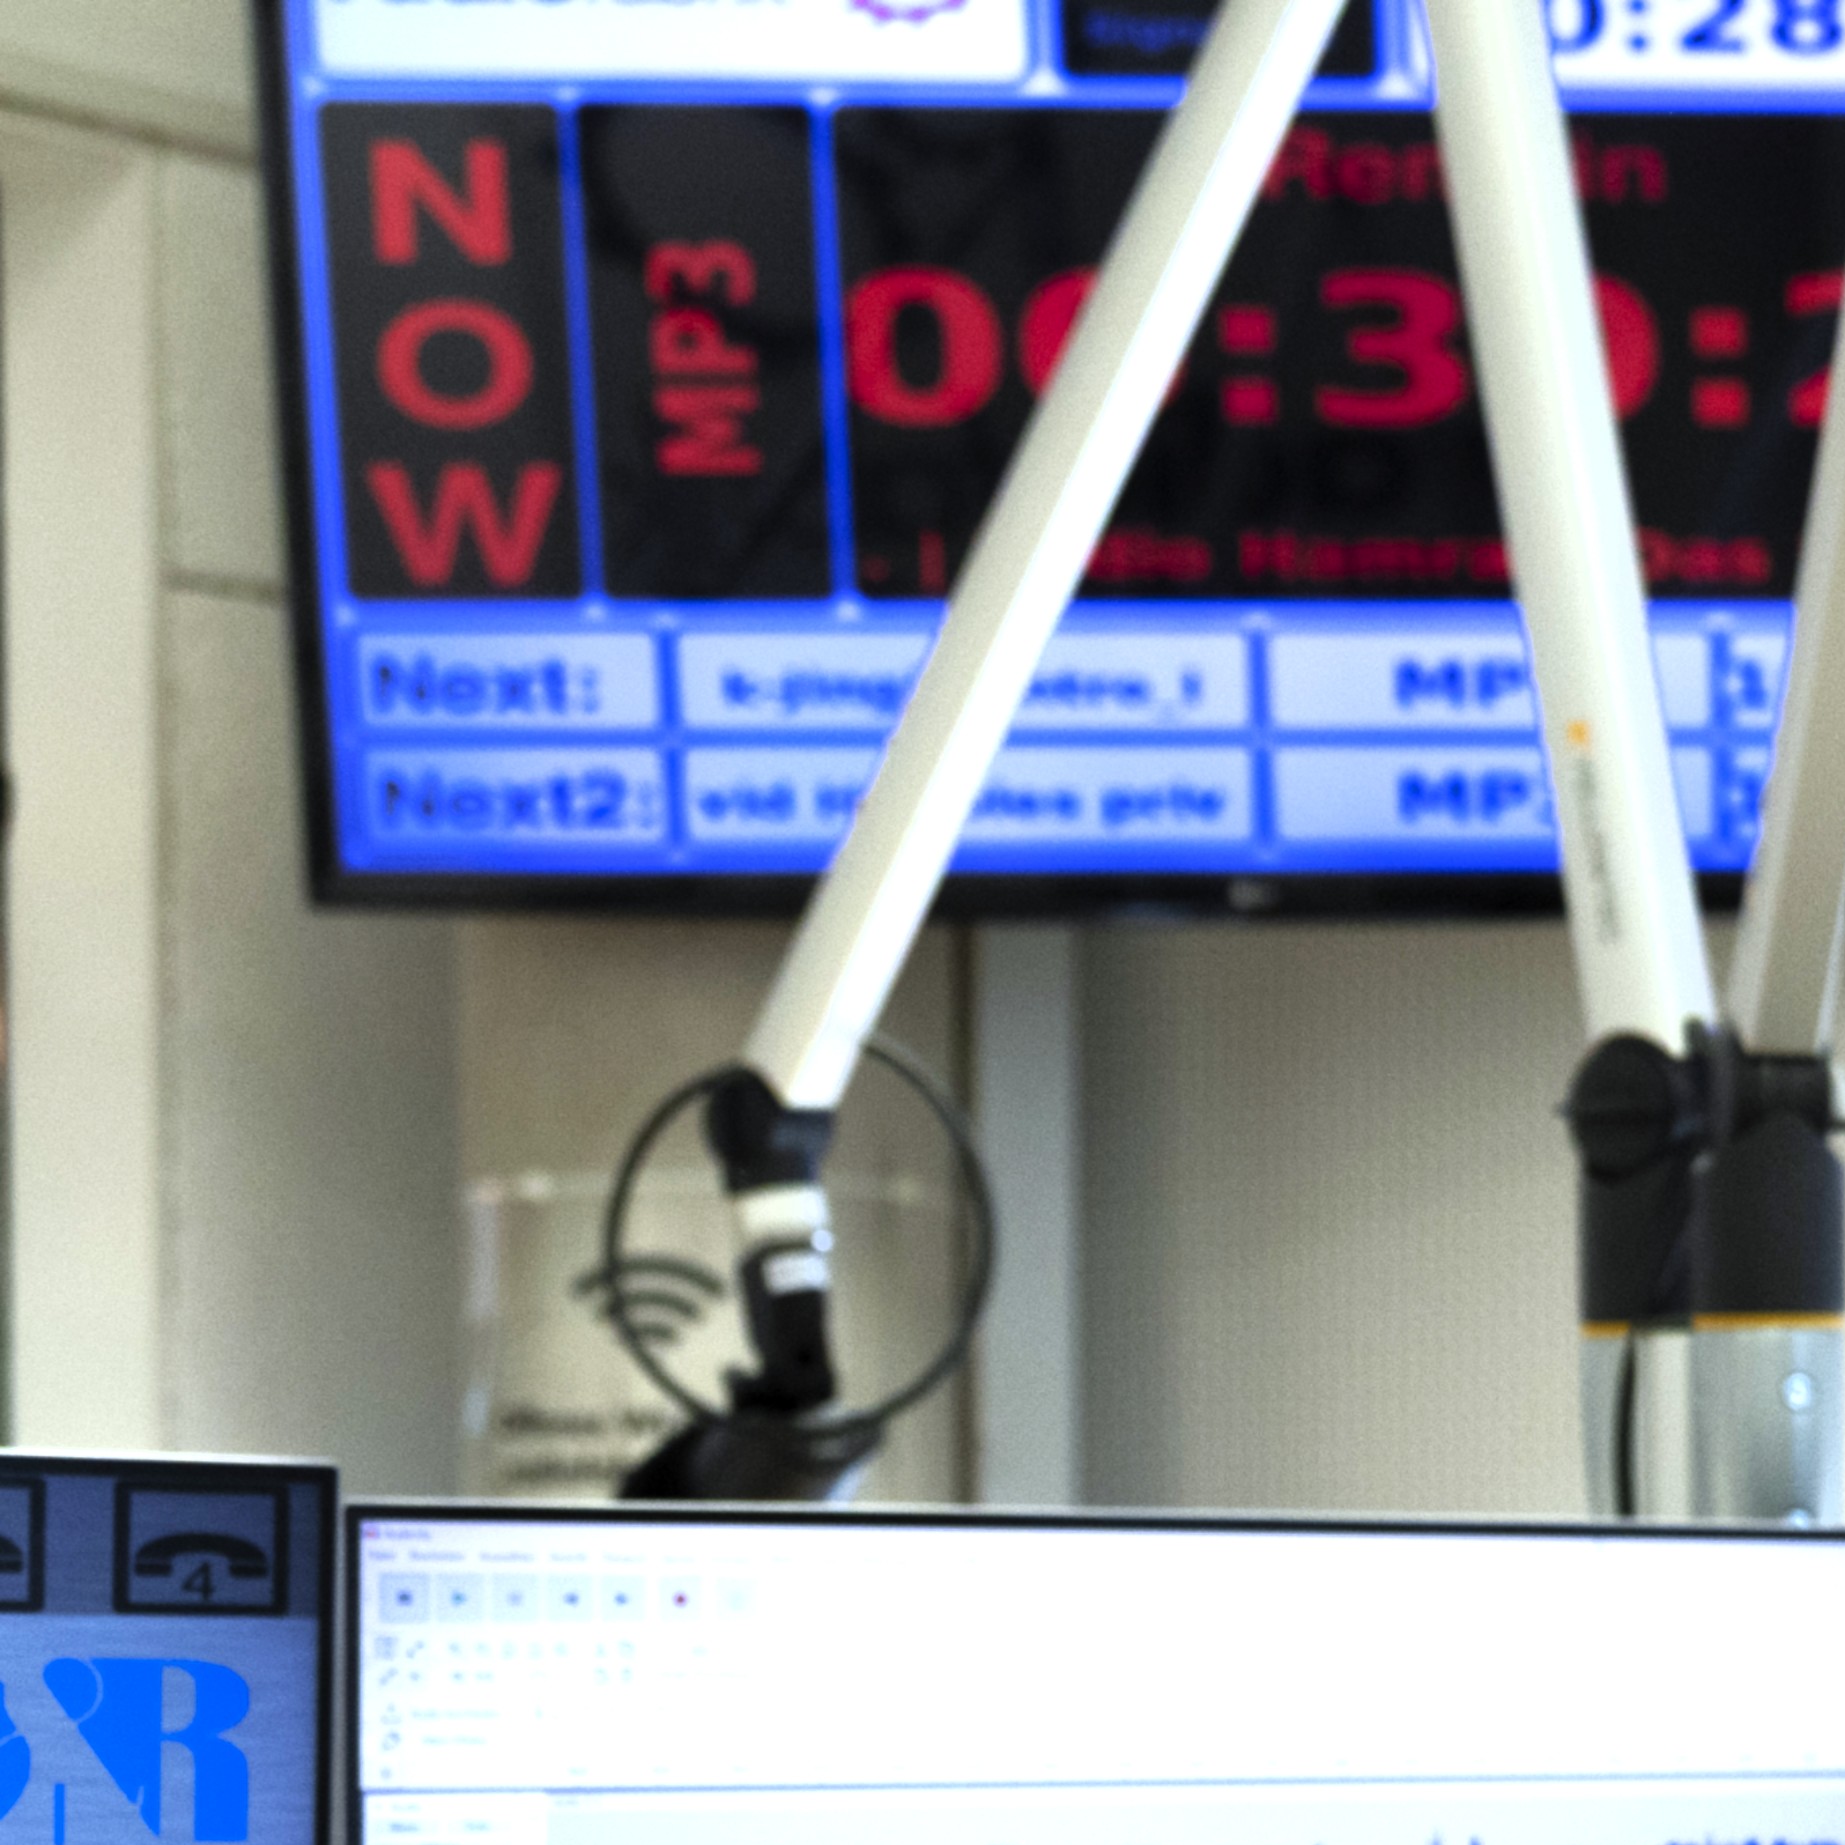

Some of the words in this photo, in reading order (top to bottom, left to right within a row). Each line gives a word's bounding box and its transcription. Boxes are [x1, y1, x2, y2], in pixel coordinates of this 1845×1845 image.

[367, 136, 563, 587] NOW
[644, 239, 763, 477] MP3
[369, 654, 599, 717] Next:
[1394, 657, 1528, 712] MP
[382, 770, 661, 833] Next2:
[1396, 768, 1556, 826] MP
[180, 1561, 216, 1600] 4
